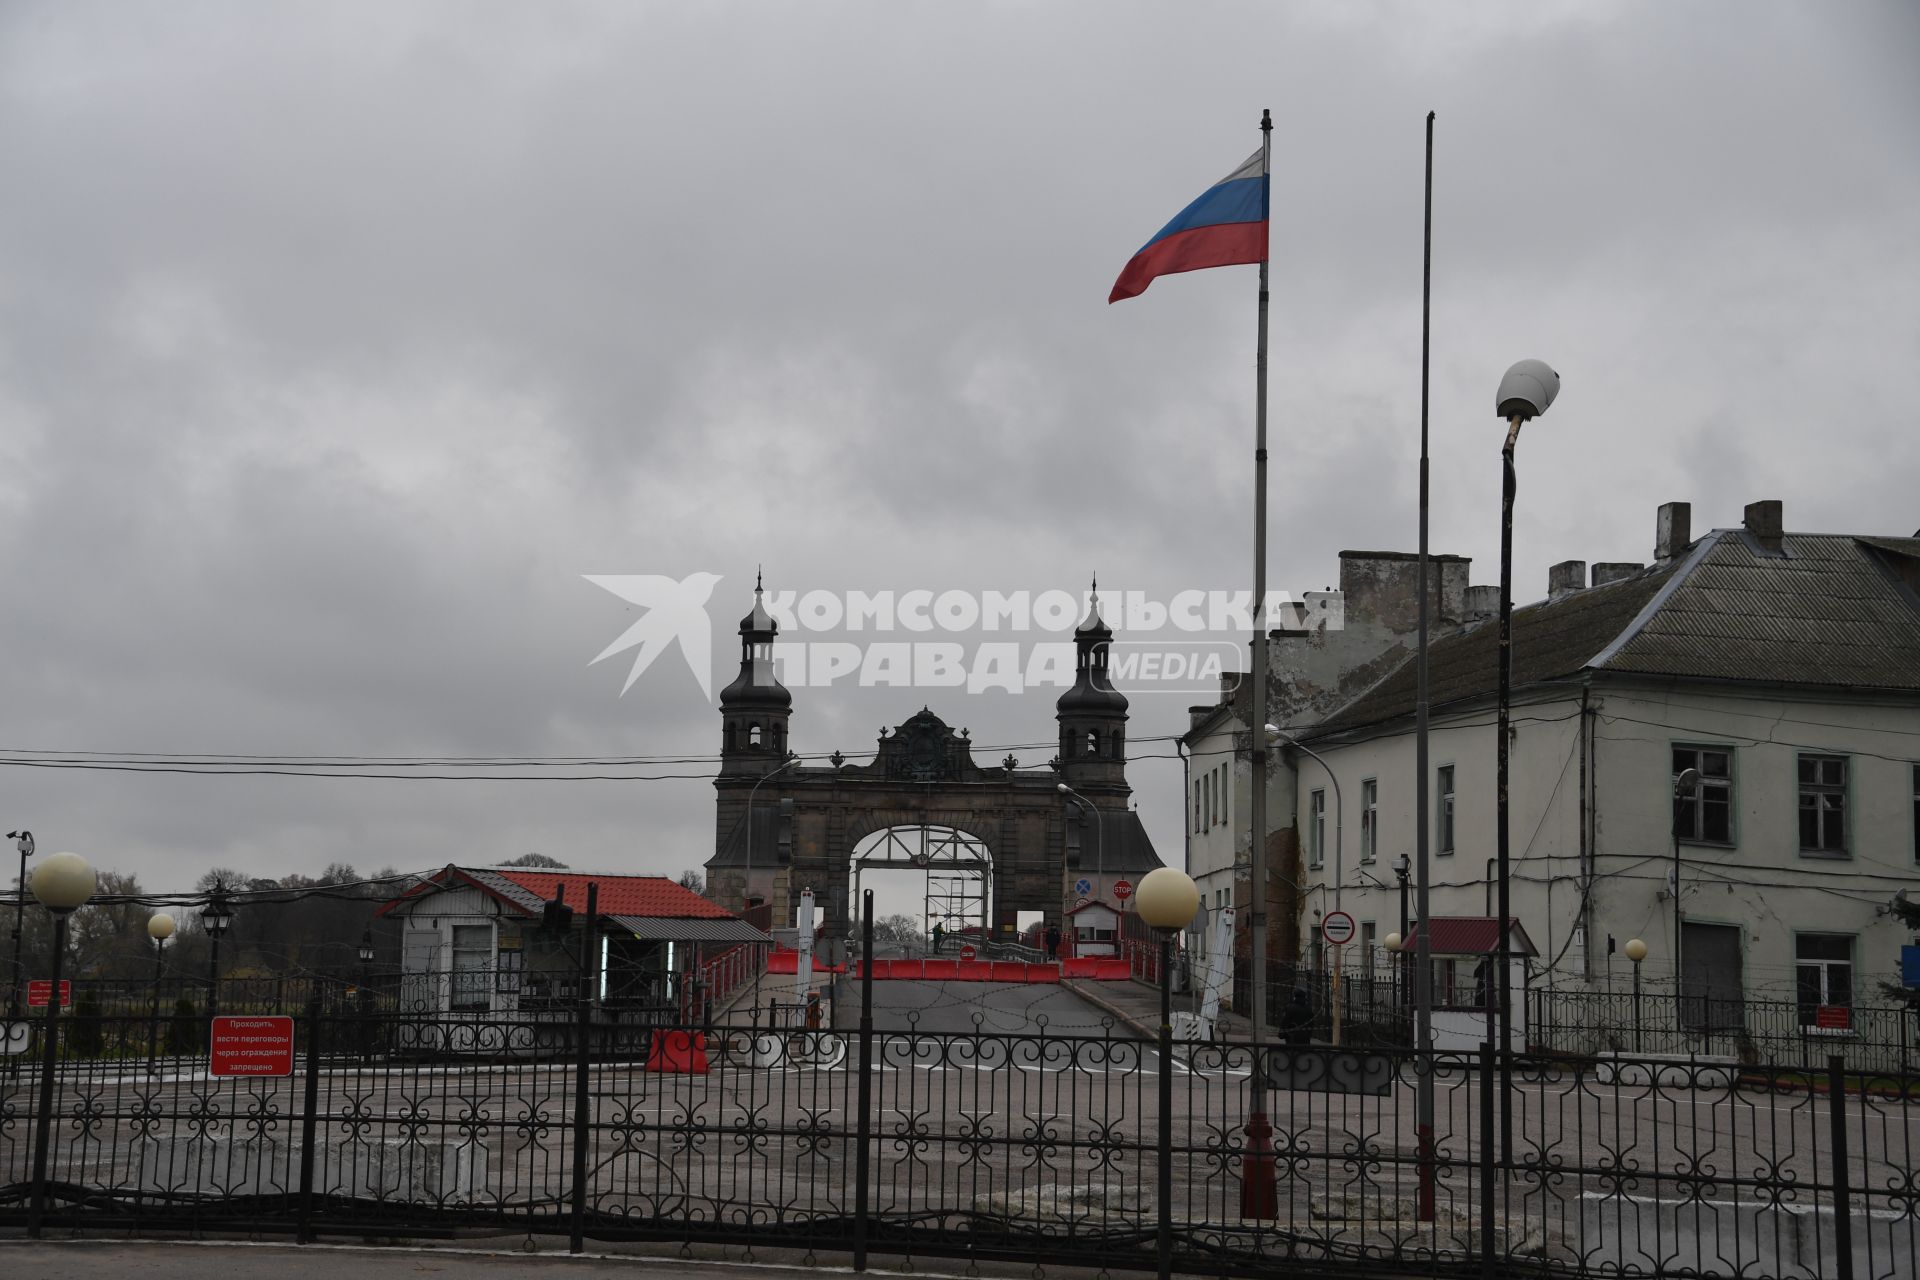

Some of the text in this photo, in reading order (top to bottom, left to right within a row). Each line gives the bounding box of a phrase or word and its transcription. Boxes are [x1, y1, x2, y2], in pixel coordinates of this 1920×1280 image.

[1114, 886, 1132, 894] STOP
[230, 1020, 275, 1029] Проходить,
[241, 1036, 289, 1044] переговоры
[216, 1049, 240, 1058] через
